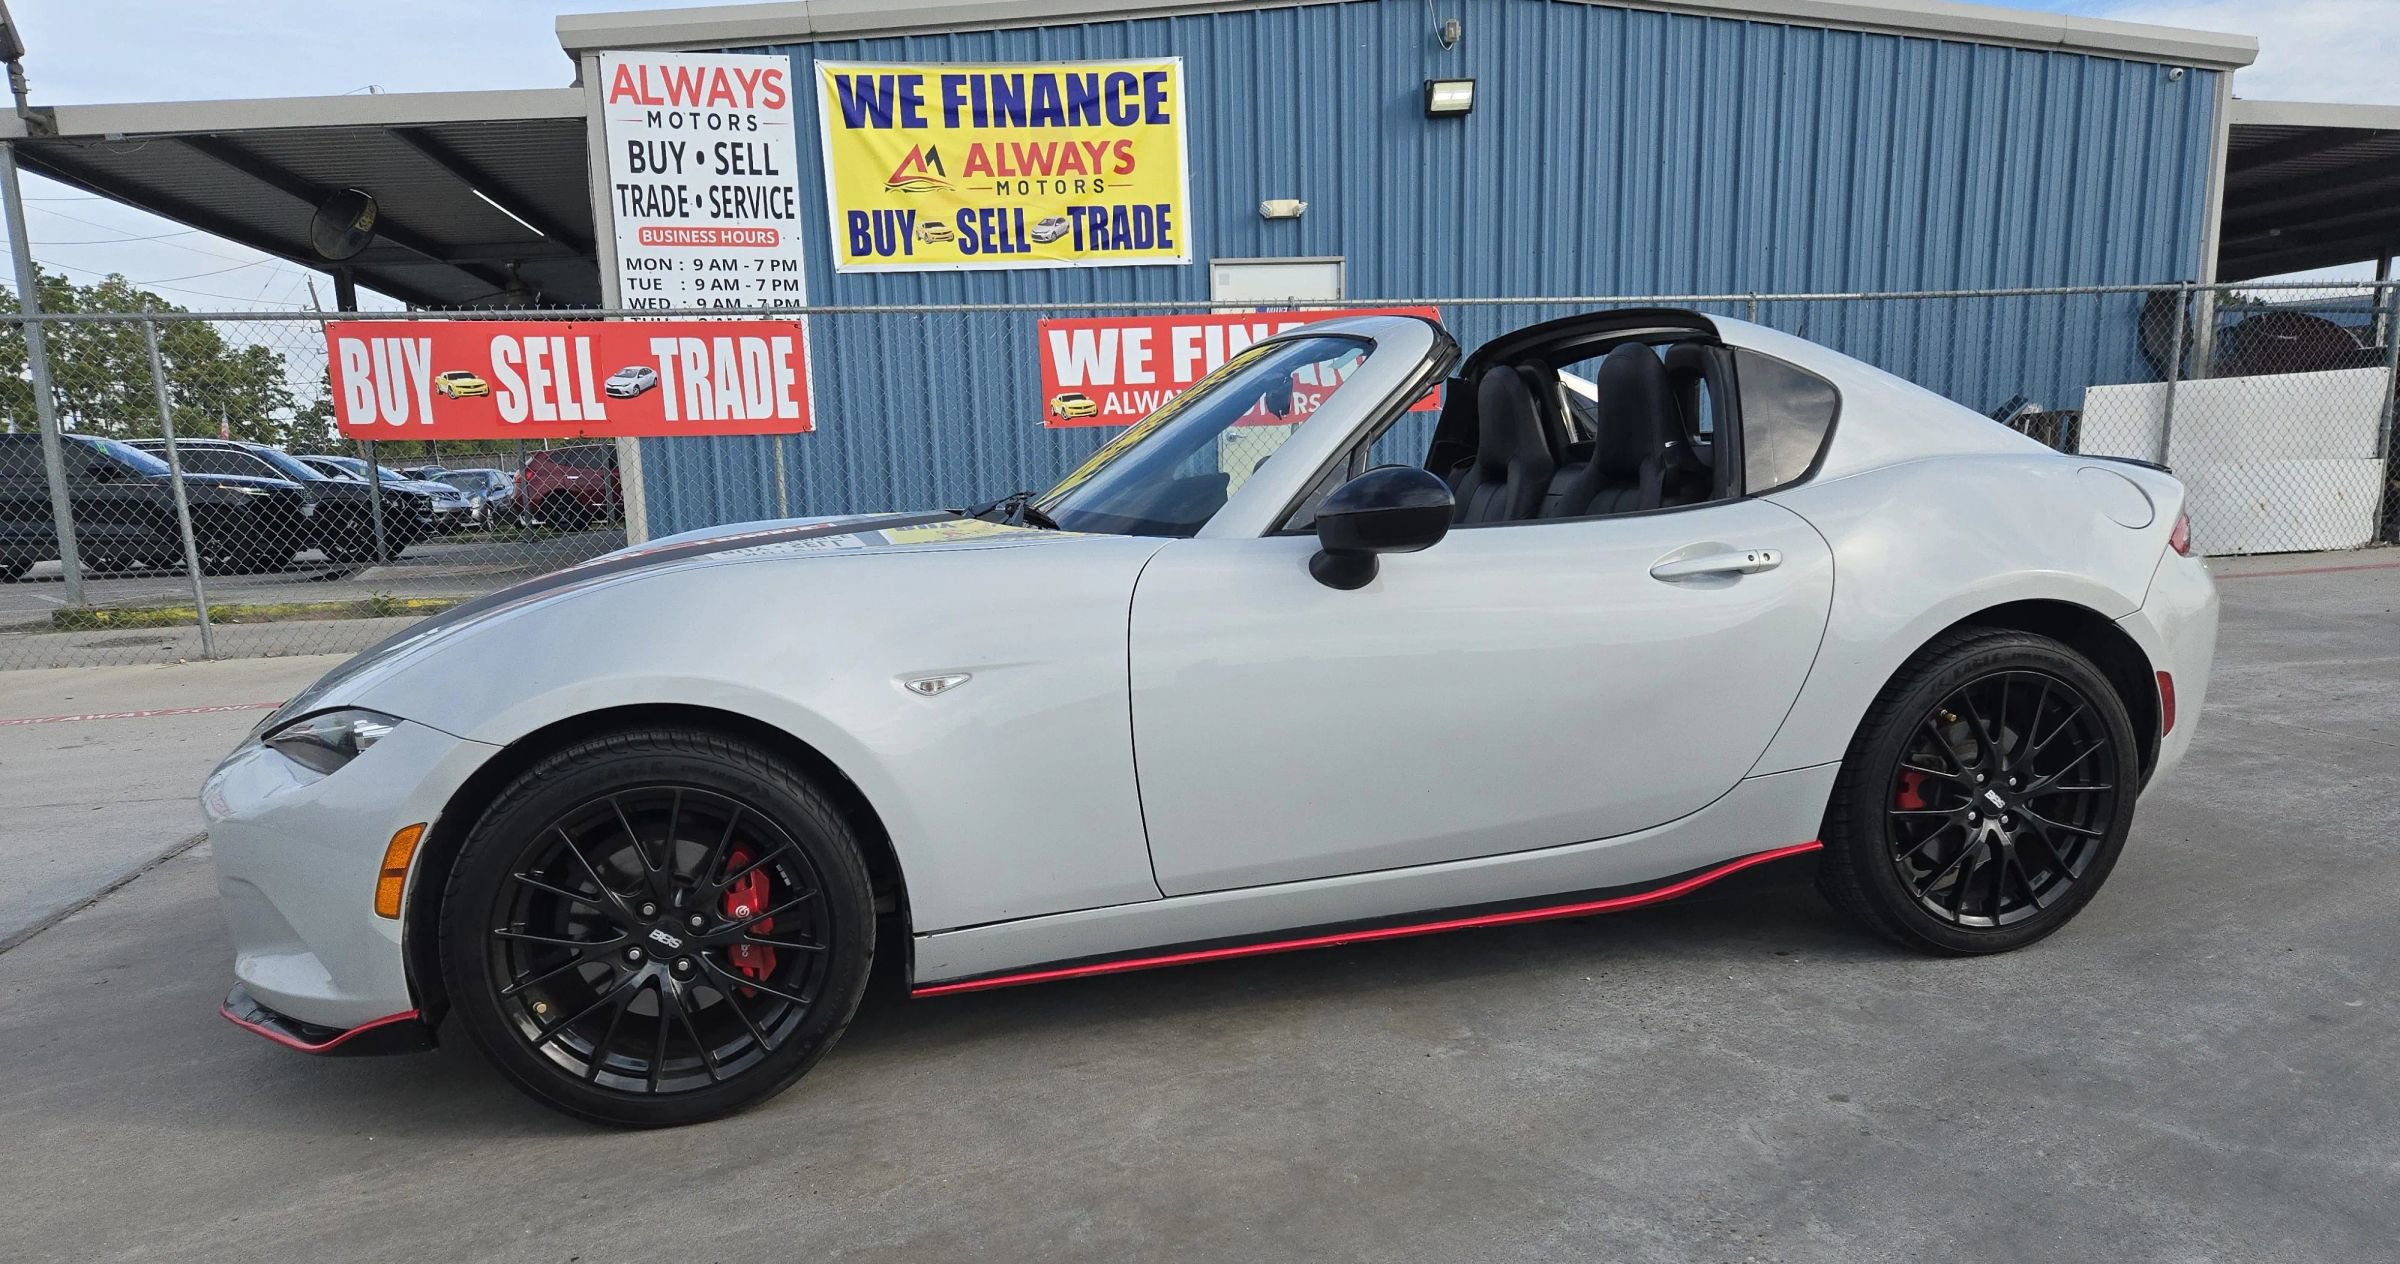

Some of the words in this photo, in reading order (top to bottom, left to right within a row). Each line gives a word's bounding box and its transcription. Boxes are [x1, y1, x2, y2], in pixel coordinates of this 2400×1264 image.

[609, 63, 786, 110] ALWAYS
[835, 73, 928, 129] WE
[940, 71, 1170, 129] FINANCE
[647, 110, 758, 131] MOTORS
[627, 140, 686, 174] BUY
[715, 141, 779, 175] SELL
[963, 139, 1136, 178] ALWAYS
[996, 178, 1105, 196] MOTORS
[617, 184, 689, 218] TRADE
[709, 185, 795, 219] SERVICE
[642, 229, 716, 244] BUSINESS
[720, 230, 775, 244] HOURS
[847, 209, 916, 257] BUY
[956, 206, 1031, 256] SELL
[1067, 203, 1173, 252] TRADE
[626, 257, 673, 271] MON
[693, 258, 703, 271] 9
[709, 258, 738, 271] AM
[754, 259, 764, 272] 7
[770, 259, 798, 272] PM
[627, 278, 663, 291] TUE
[695, 278, 705, 291] 9
[710, 278, 740, 291] AM
[756, 278, 766, 291] 7
[772, 278, 799, 292] PM
[629, 298, 671, 310] WED
[712, 298, 741, 309] AM
[773, 298, 800, 309] PM
[1048, 326, 1158, 387] WE
[338, 336, 433, 426] BUY
[490, 334, 607, 423] SELL
[650, 335, 799, 421] TRADE
[1984, 790, 2006, 809] BBS
[648, 928, 683, 949] BBS
